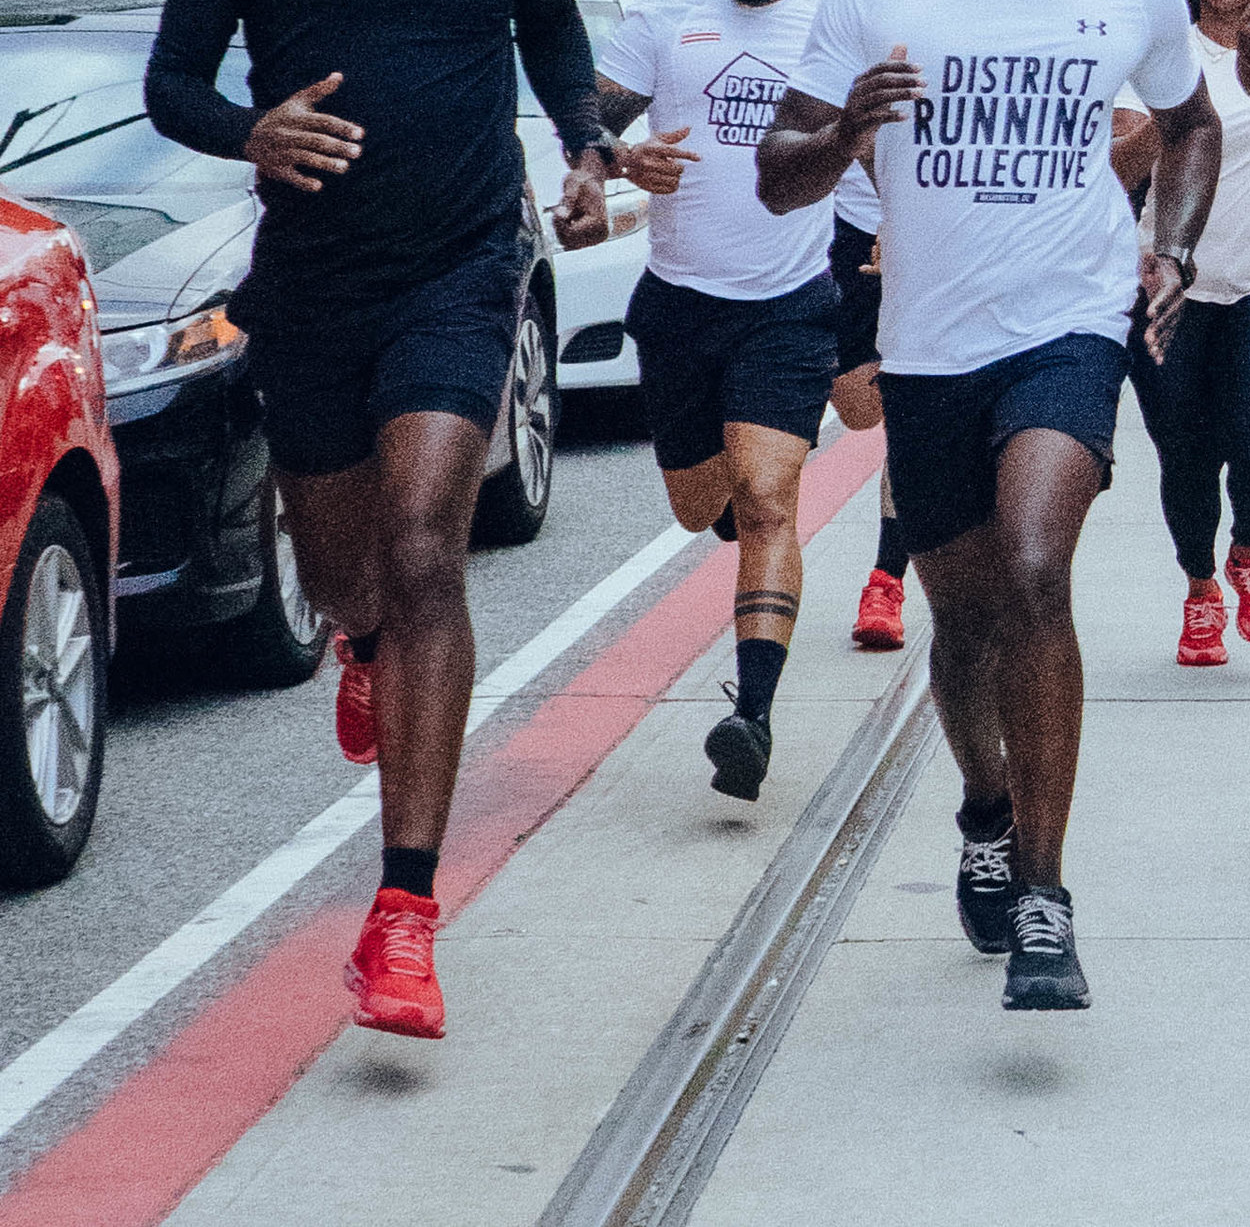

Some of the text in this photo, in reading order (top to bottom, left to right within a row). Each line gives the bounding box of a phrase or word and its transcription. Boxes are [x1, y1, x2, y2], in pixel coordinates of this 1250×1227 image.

[941, 55, 1099, 96] DISTRICT
[913, 96, 1105, 147] RUNNING
[916, 148, 1088, 189] COLLECTIVE
